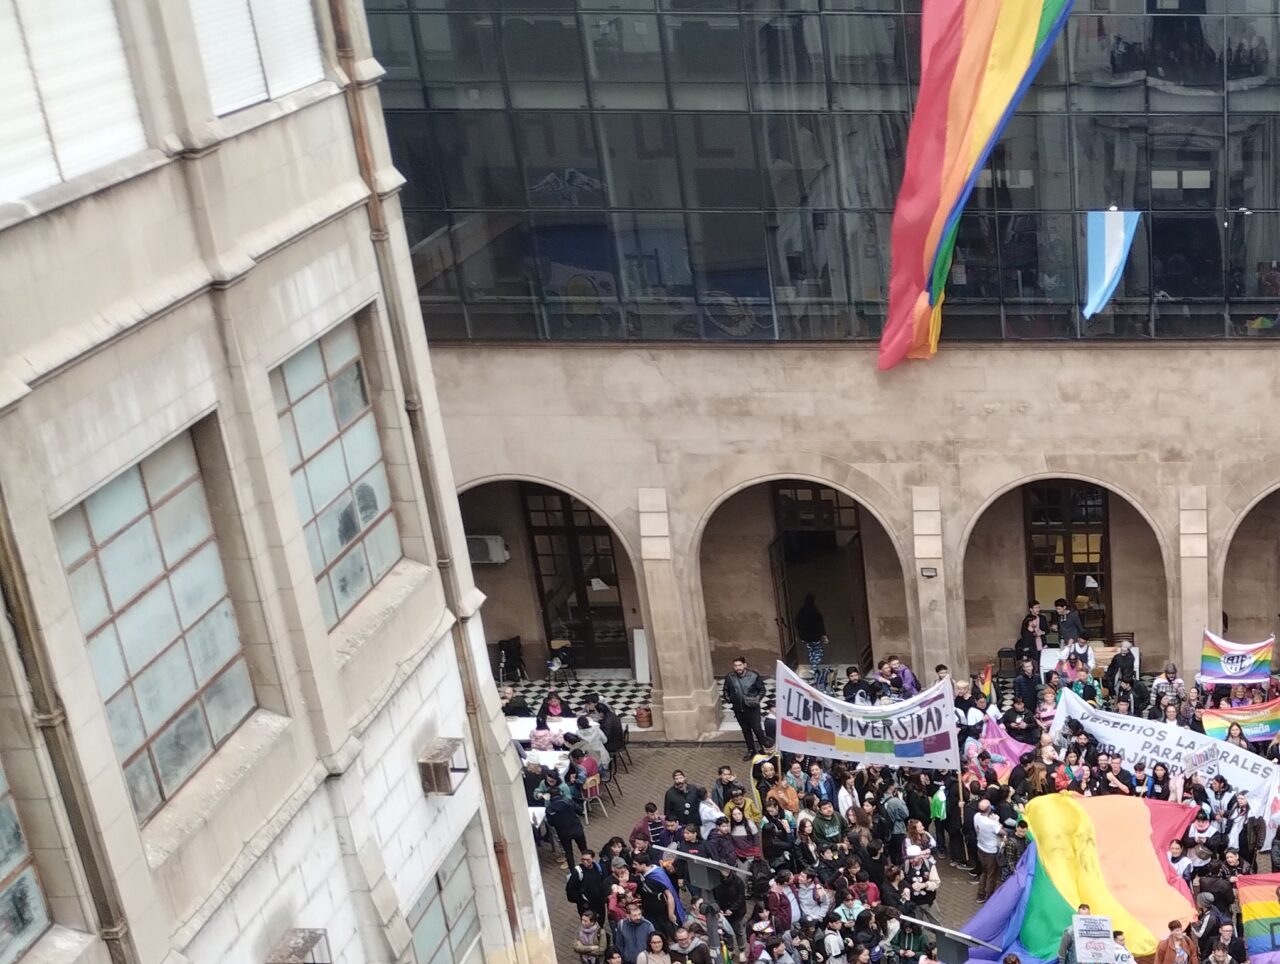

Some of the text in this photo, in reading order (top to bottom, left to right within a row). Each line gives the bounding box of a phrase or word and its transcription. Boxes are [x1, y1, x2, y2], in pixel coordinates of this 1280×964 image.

[786, 688, 944, 741] LIBRE DIVERSIDAD
[1143, 741, 1183, 766] PARA
[1176, 735, 1273, 780] LARALES
